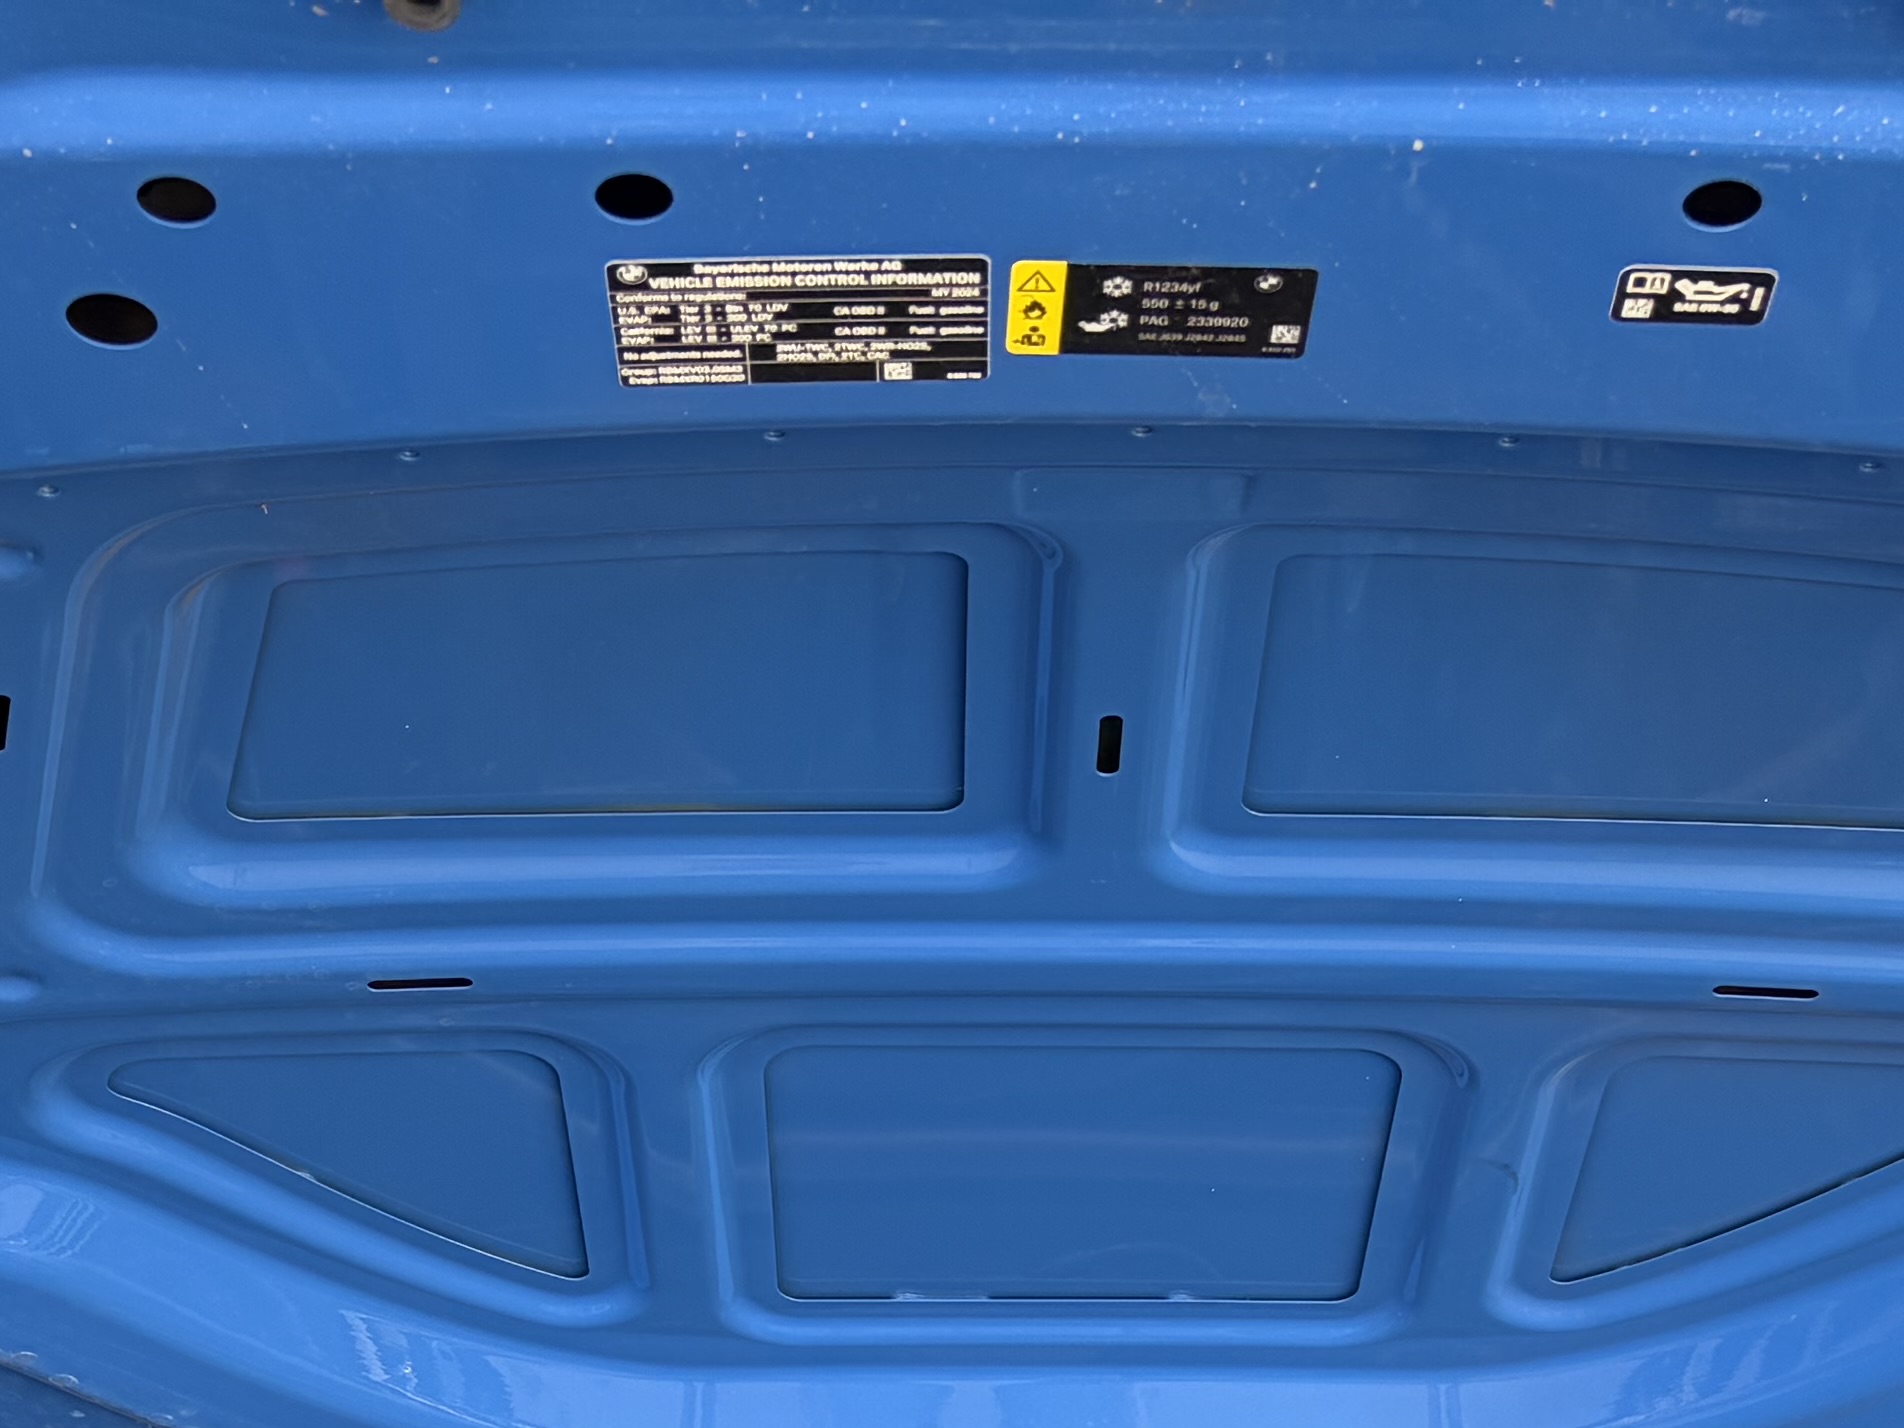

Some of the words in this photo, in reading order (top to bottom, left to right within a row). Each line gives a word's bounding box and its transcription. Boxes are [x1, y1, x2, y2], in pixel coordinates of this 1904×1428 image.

[694, 263, 770, 274] Bayerische
[772, 262, 832, 272] Motoren
[834, 261, 878, 270] Werke
[881, 261, 902, 270] AG
[649, 277, 713, 289] VEHICLE
[716, 275, 792, 288] EMISSION
[795, 274, 868, 286] CONTROL
[871, 272, 981, 284] INFORMATION
[952, 288, 980, 297] 2024
[1144, 282, 1201, 294] R1234yf
[616, 294, 668, 302] Conforms
[671, 293, 682, 301] to
[767, 304, 788, 312] LDV
[1142, 299, 1169, 309] 550
[1190, 299, 1207, 309] 15
[1210, 301, 1219, 311] g
[1140, 316, 1169, 325] PAG
[624, 352, 638, 360] No
